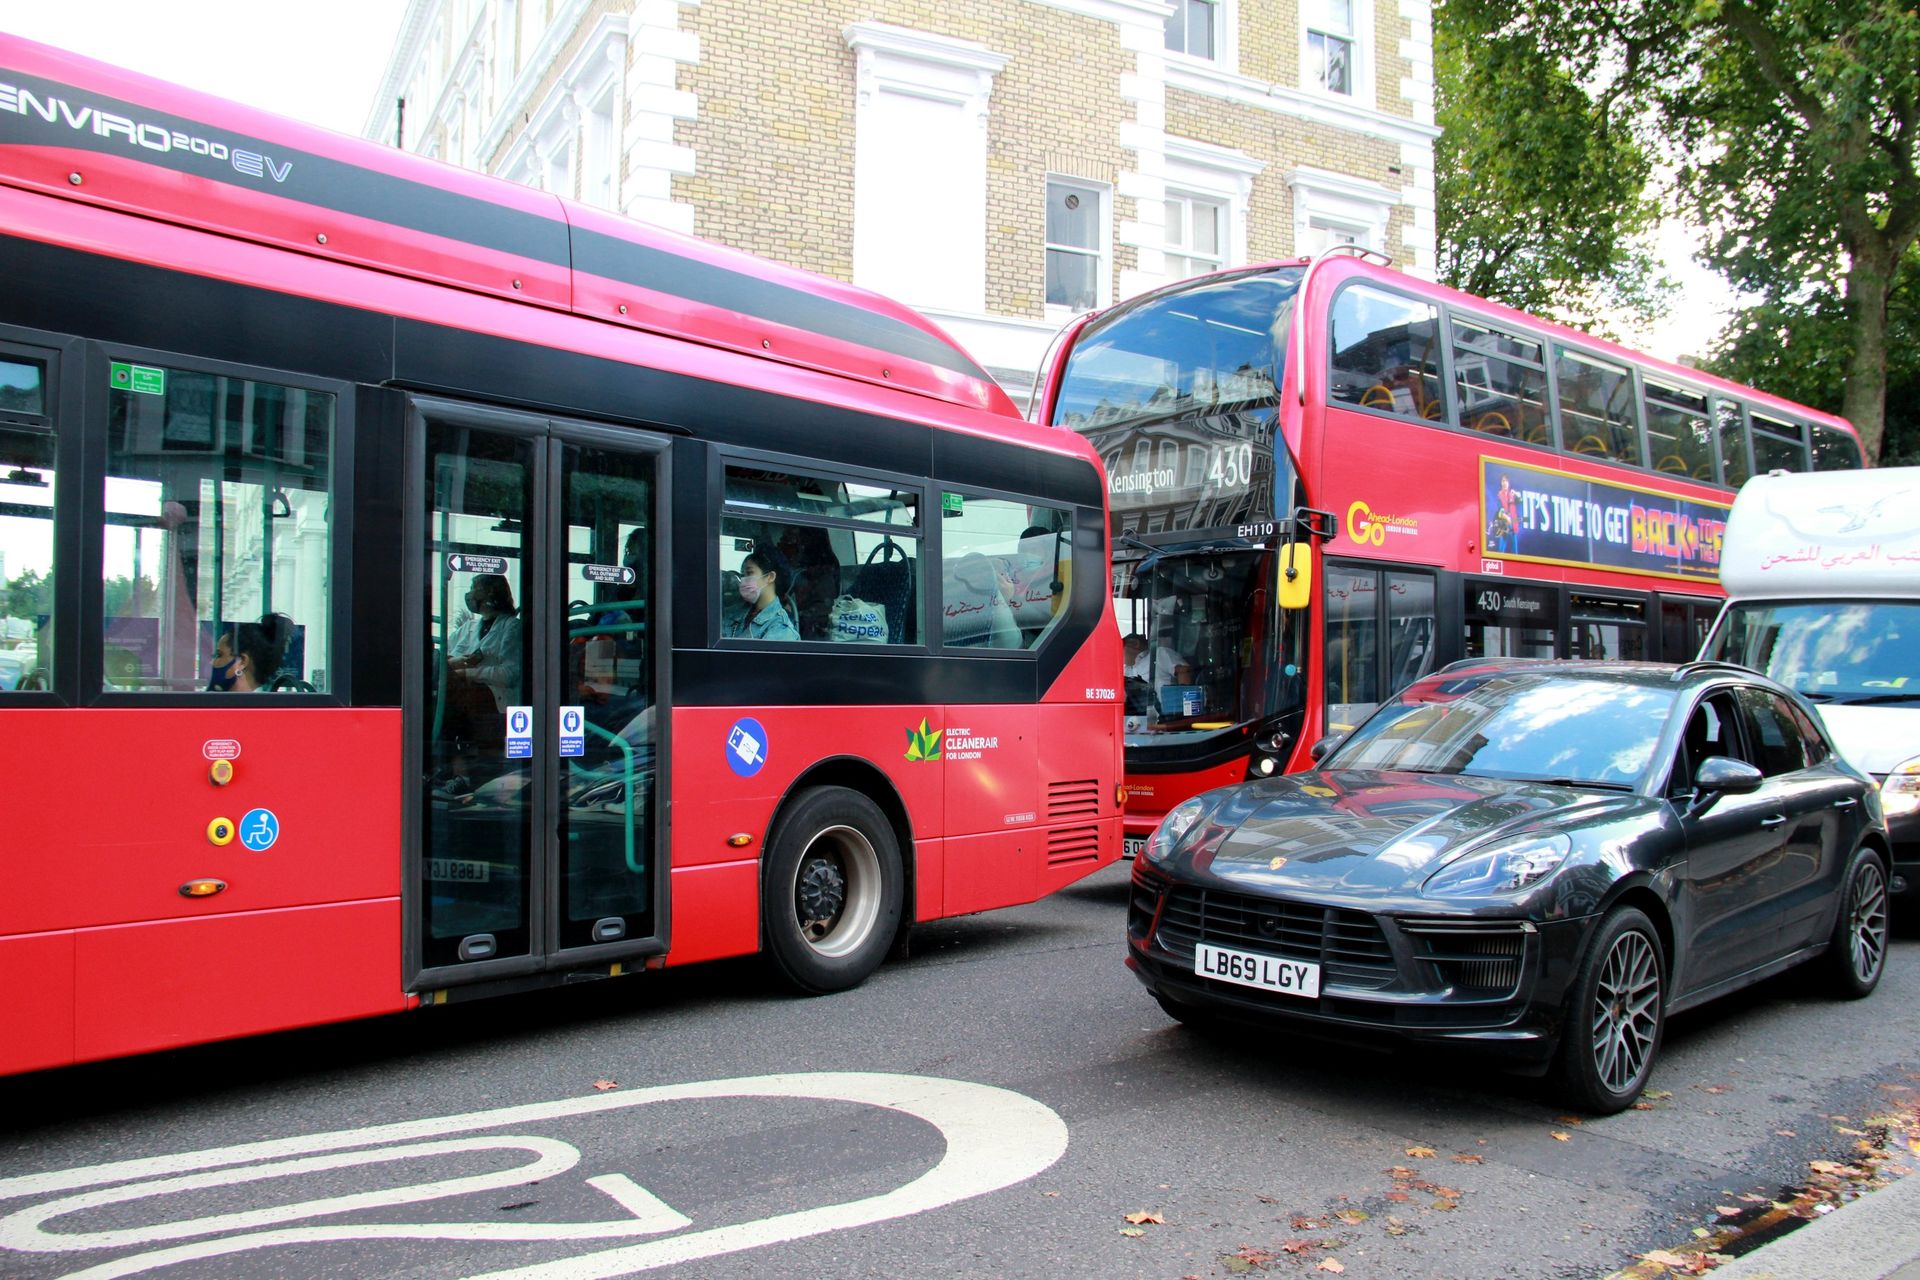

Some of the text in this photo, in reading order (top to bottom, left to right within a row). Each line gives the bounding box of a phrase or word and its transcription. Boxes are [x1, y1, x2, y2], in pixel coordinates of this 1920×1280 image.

[231, 148, 293, 183] EV
[1107, 443, 1251, 495] Kensington 430
[1237, 523, 1274, 538] EH110
[1551, 495, 1583, 537] TIME
[1584, 501, 1602, 541] TO
[1604, 506, 1629, 545] GET
[1631, 504, 1693, 560] BACK
[1477, 590, 1501, 612] 430
[1086, 688, 1115, 700] BE 37026
[946, 728, 971, 736] ELECTRIC
[946, 751, 982, 760] FOR LONDON
[1204, 949, 1309, 990] LB69 LGY
